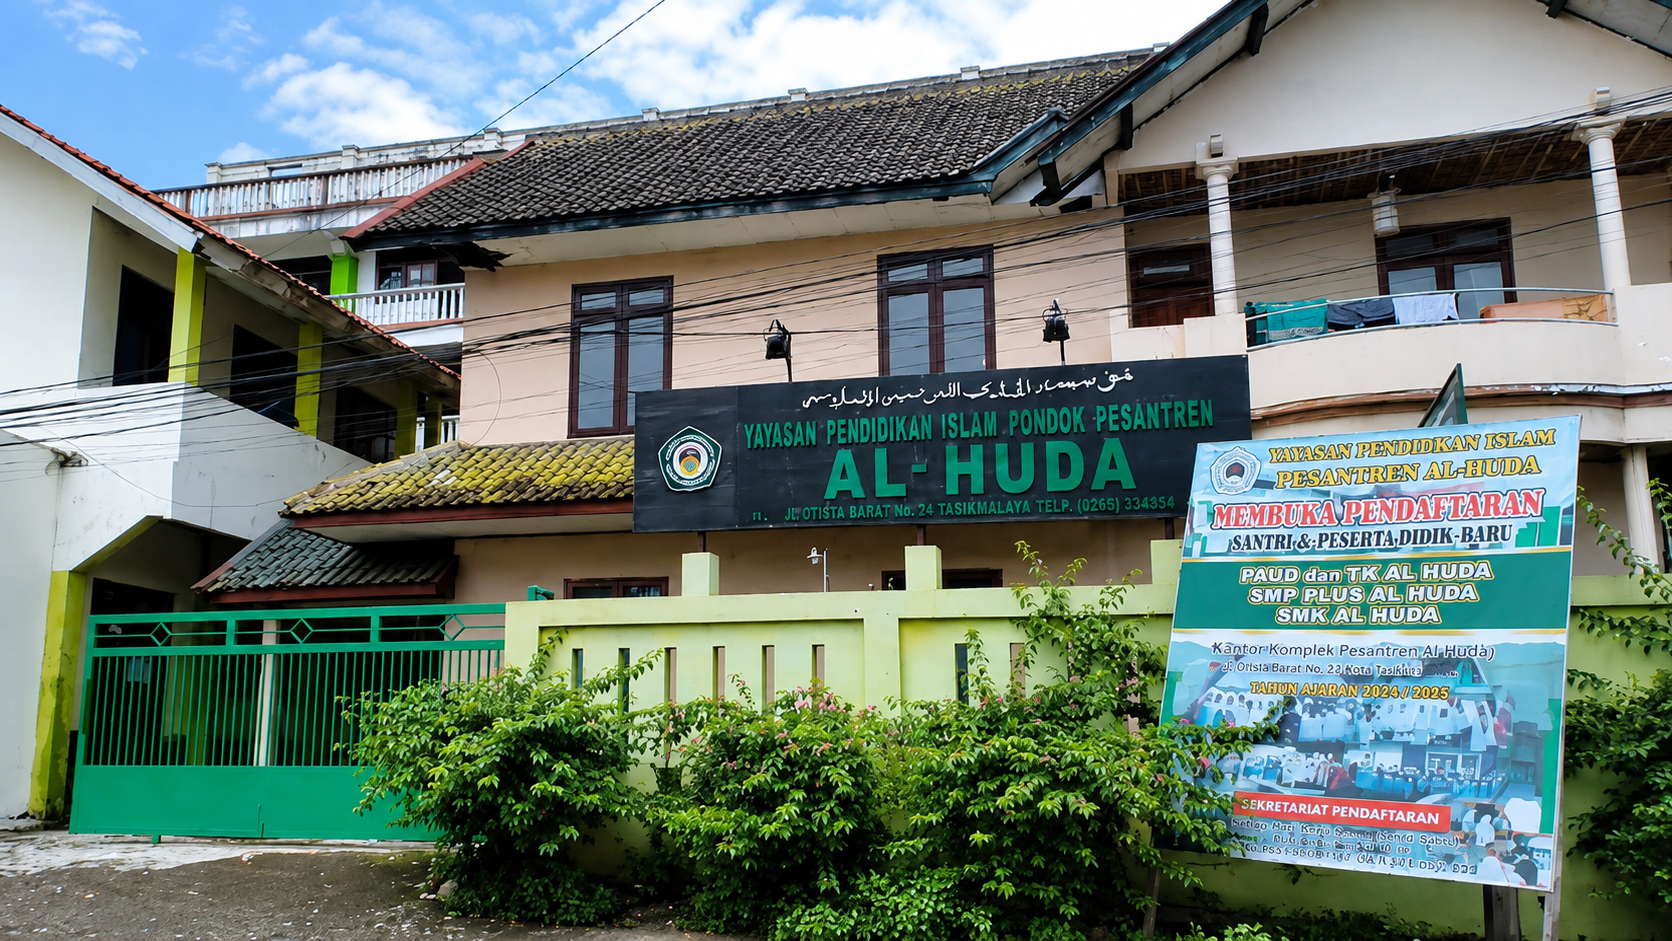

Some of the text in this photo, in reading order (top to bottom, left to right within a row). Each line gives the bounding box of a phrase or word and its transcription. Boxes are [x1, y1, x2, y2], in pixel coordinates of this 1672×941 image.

[744, 399, 1214, 449] YAYASAN PENDIDIKAN ISLAM PONDOK PESANTREN
[1268, 443, 1352, 464] YAYASAN
[1484, 428, 1556, 450] ISLAM
[1275, 463, 1420, 489] PESANTREN
[1422, 455, 1541, 481] AL-HUDA
[802, 506, 845, 520] OTISTA
[849, 504, 891, 518] BARAT
[894, 504, 915, 517] No.
[918, 503, 934, 516] 24
[938, 500, 1031, 516] TASIKMALAYA
[1036, 499, 1073, 513] TELP.
[1077, 497, 1120, 514] (0265)
[1212, 488, 1545, 530] MEMBUKA PENDAFTARAN
[1232, 533, 1292, 551] SANTRI
[1239, 560, 1494, 584] PAUD dan TK AL HUDA
[1248, 582, 1480, 604] SMP PLUS AL HUDA
[1275, 604, 1442, 625] SMK AL HUDA
[1269, 643, 1335, 658] Komplek
[1340, 644, 1418, 657] Pesantren
[1423, 645, 1438, 657] Al
[1271, 662, 1302, 673] Barat
[1305, 664, 1323, 674] No.
[1250, 681, 1298, 695] TAHUN
[1300, 683, 1359, 697] AJARAN
[1241, 798, 1439, 825] SEKRETARIAT PENDAFTARAN
